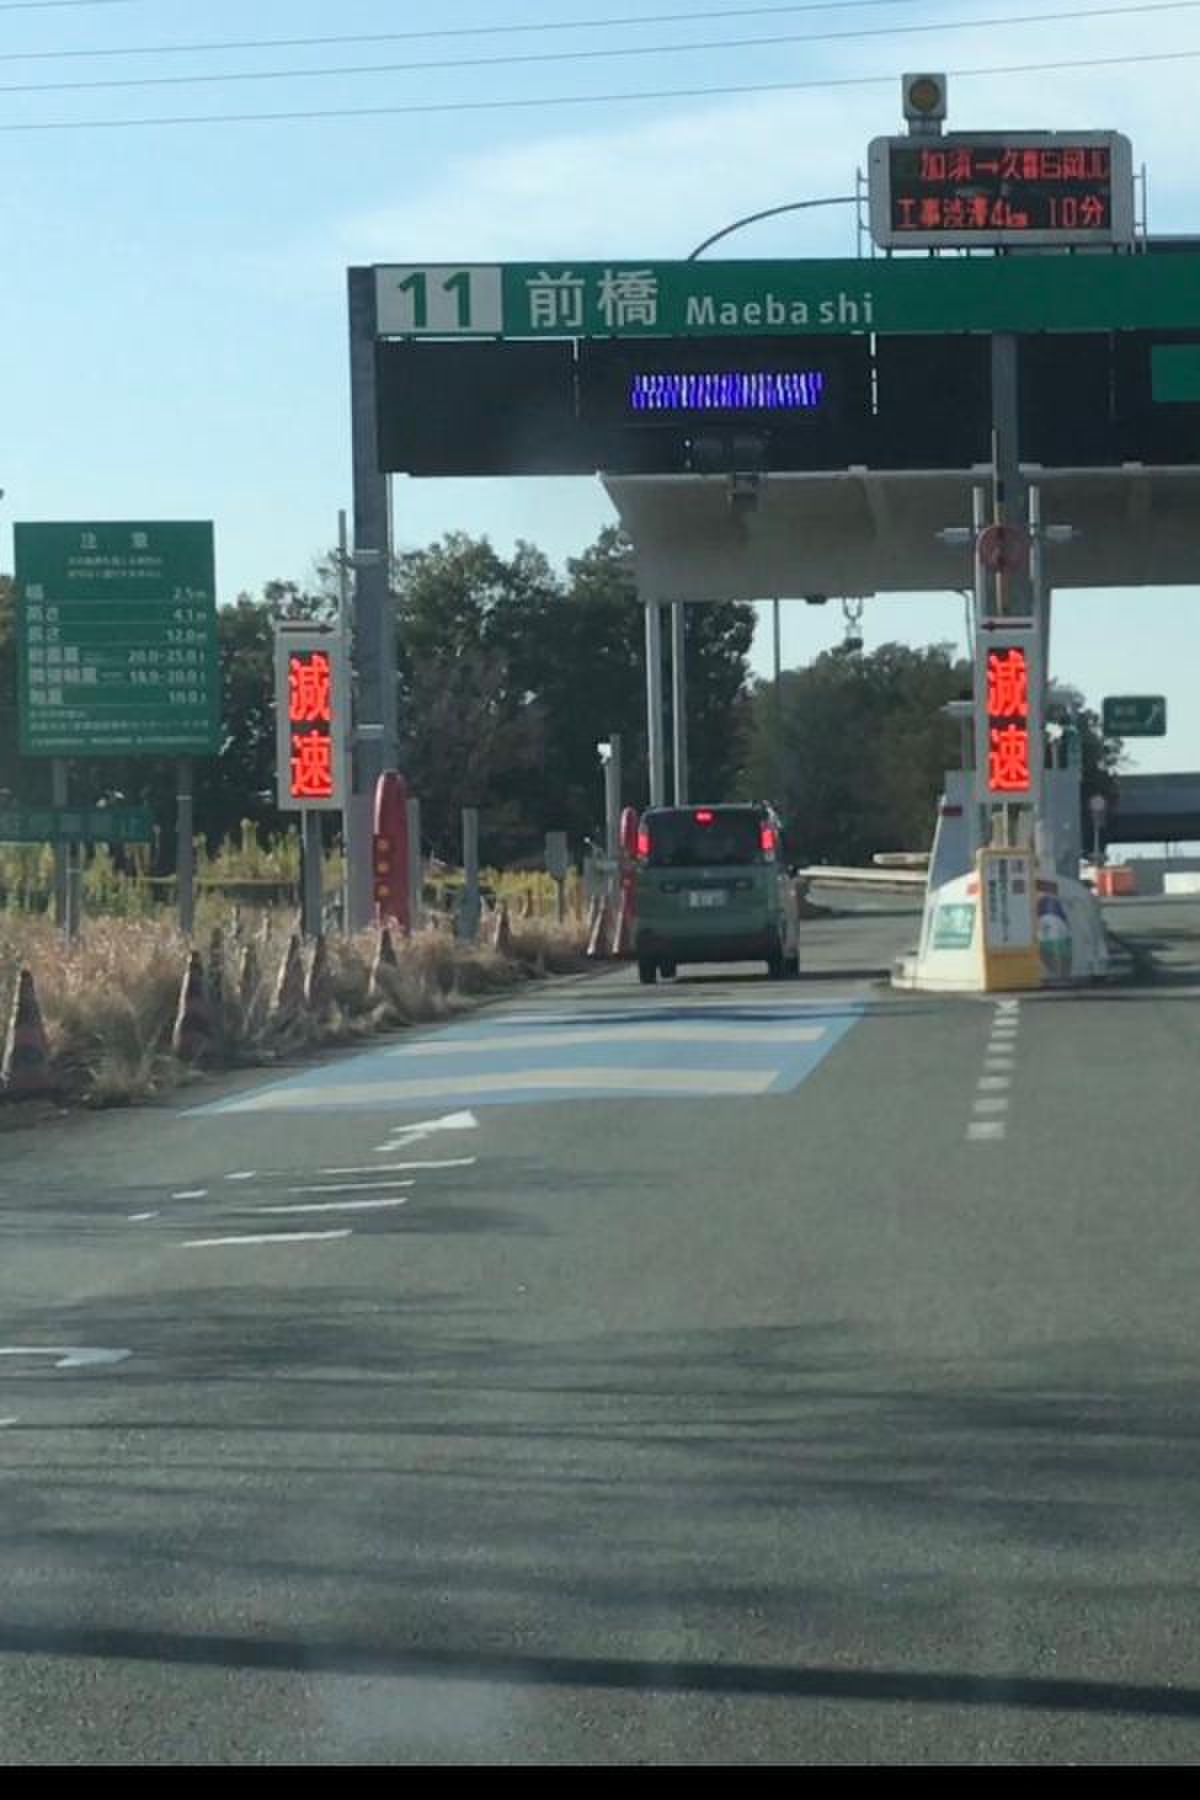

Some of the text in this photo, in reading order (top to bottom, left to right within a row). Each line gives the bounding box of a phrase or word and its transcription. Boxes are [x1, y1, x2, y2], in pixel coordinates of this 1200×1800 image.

[398, 271, 472, 328] 11
[526, 270, 657, 328] 前橋
[289, 653, 333, 799] 減速
[986, 649, 1030, 792] 減速
